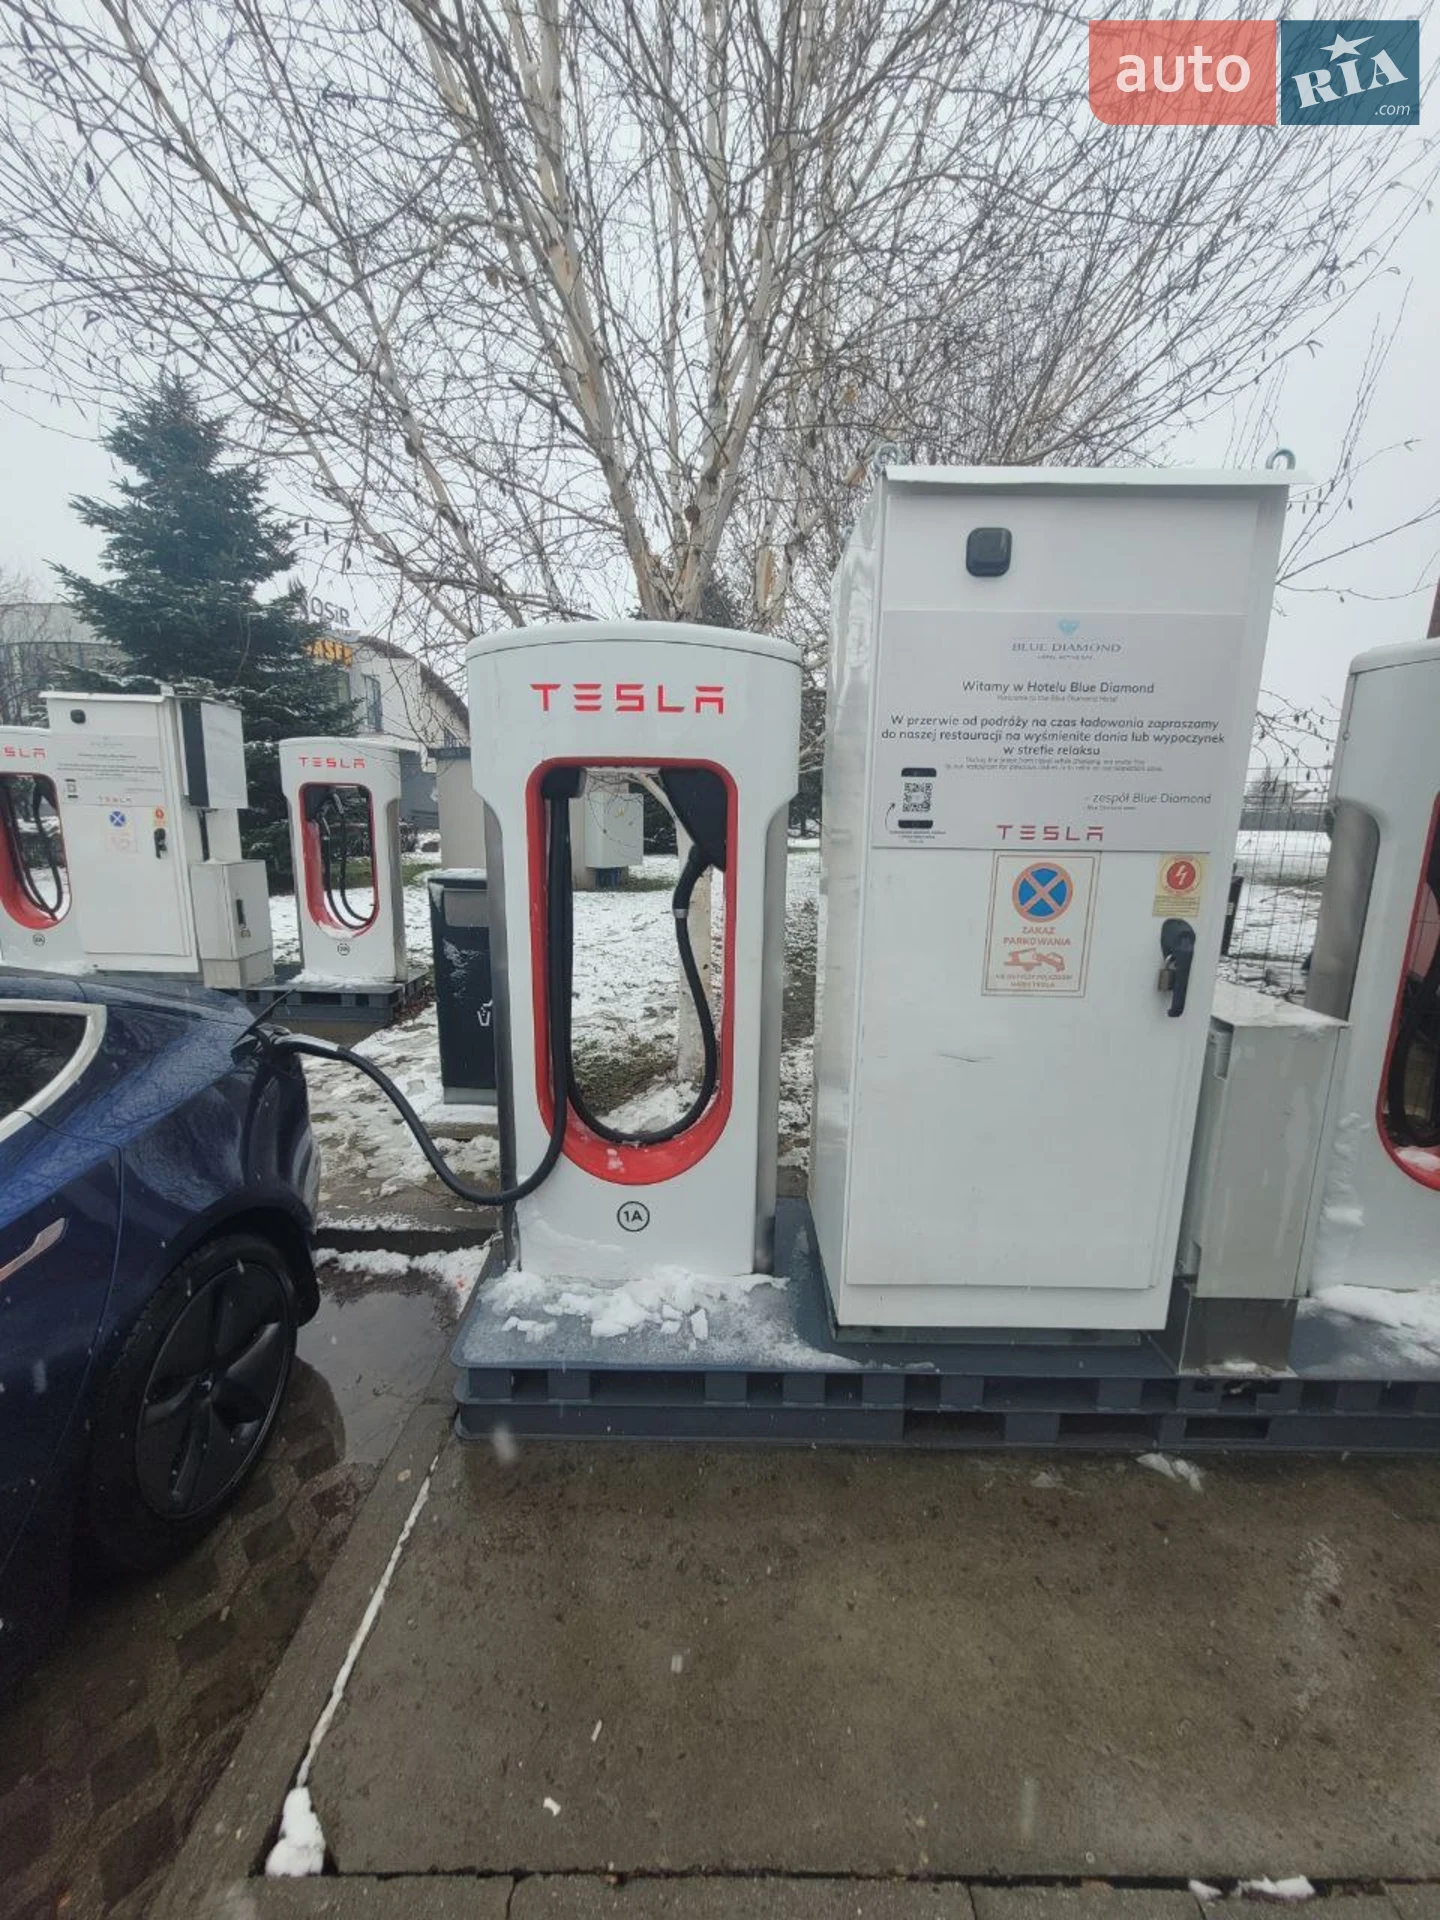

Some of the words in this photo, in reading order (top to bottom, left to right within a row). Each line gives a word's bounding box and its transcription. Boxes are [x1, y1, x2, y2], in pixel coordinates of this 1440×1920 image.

[1012, 643, 1049, 651] BLUE
[1052, 643, 1121, 653] DIAMOND
[962, 680, 1009, 695] Witamy
[1013, 684, 1023, 692] w
[1027, 681, 1066, 693] Hotelu
[1070, 682, 1096, 693] Blue
[1100, 682, 1155, 694] Diamond
[530, 684, 724, 714] TESLA
[891, 715, 903, 725] W
[907, 715, 960, 728] przerwie
[962, 715, 978, 726] od
[980, 716, 1028, 729] podróży
[1032, 718, 1047, 727] na
[1050, 718, 1077, 727] czas
[1079, 717, 1144, 728] ładowania
[1148, 719, 1219, 731] zapraszamy
[881, 729, 896, 739] do
[899, 729, 937, 742] naszej
[940, 730, 1002, 743] restauracji
[1006, 733, 1020, 741] na
[1024, 731, 1091, 743] wyśmienite
[1094, 731, 1128, 742] dania
[1131, 732, 1150, 742] lub
[1153, 733, 1225, 745] wypoczynek
[1003, 746, 1014, 755] w
[1017, 744, 1054, 755] strefie
[1057, 745, 1101, 756] relaksu
[299, 756, 366, 769] TESLA
[1093, 793, 1130, 804] zespół
[1132, 793, 1157, 803] Blue
[1160, 793, 1212, 804] Diamond
[996, 825, 1104, 841] TESLA
[1022, 926, 1056, 935] ZAKAZ
[1003, 936, 1071, 946] PARKOWANIA
[623, 1210, 643, 1222] 1A
